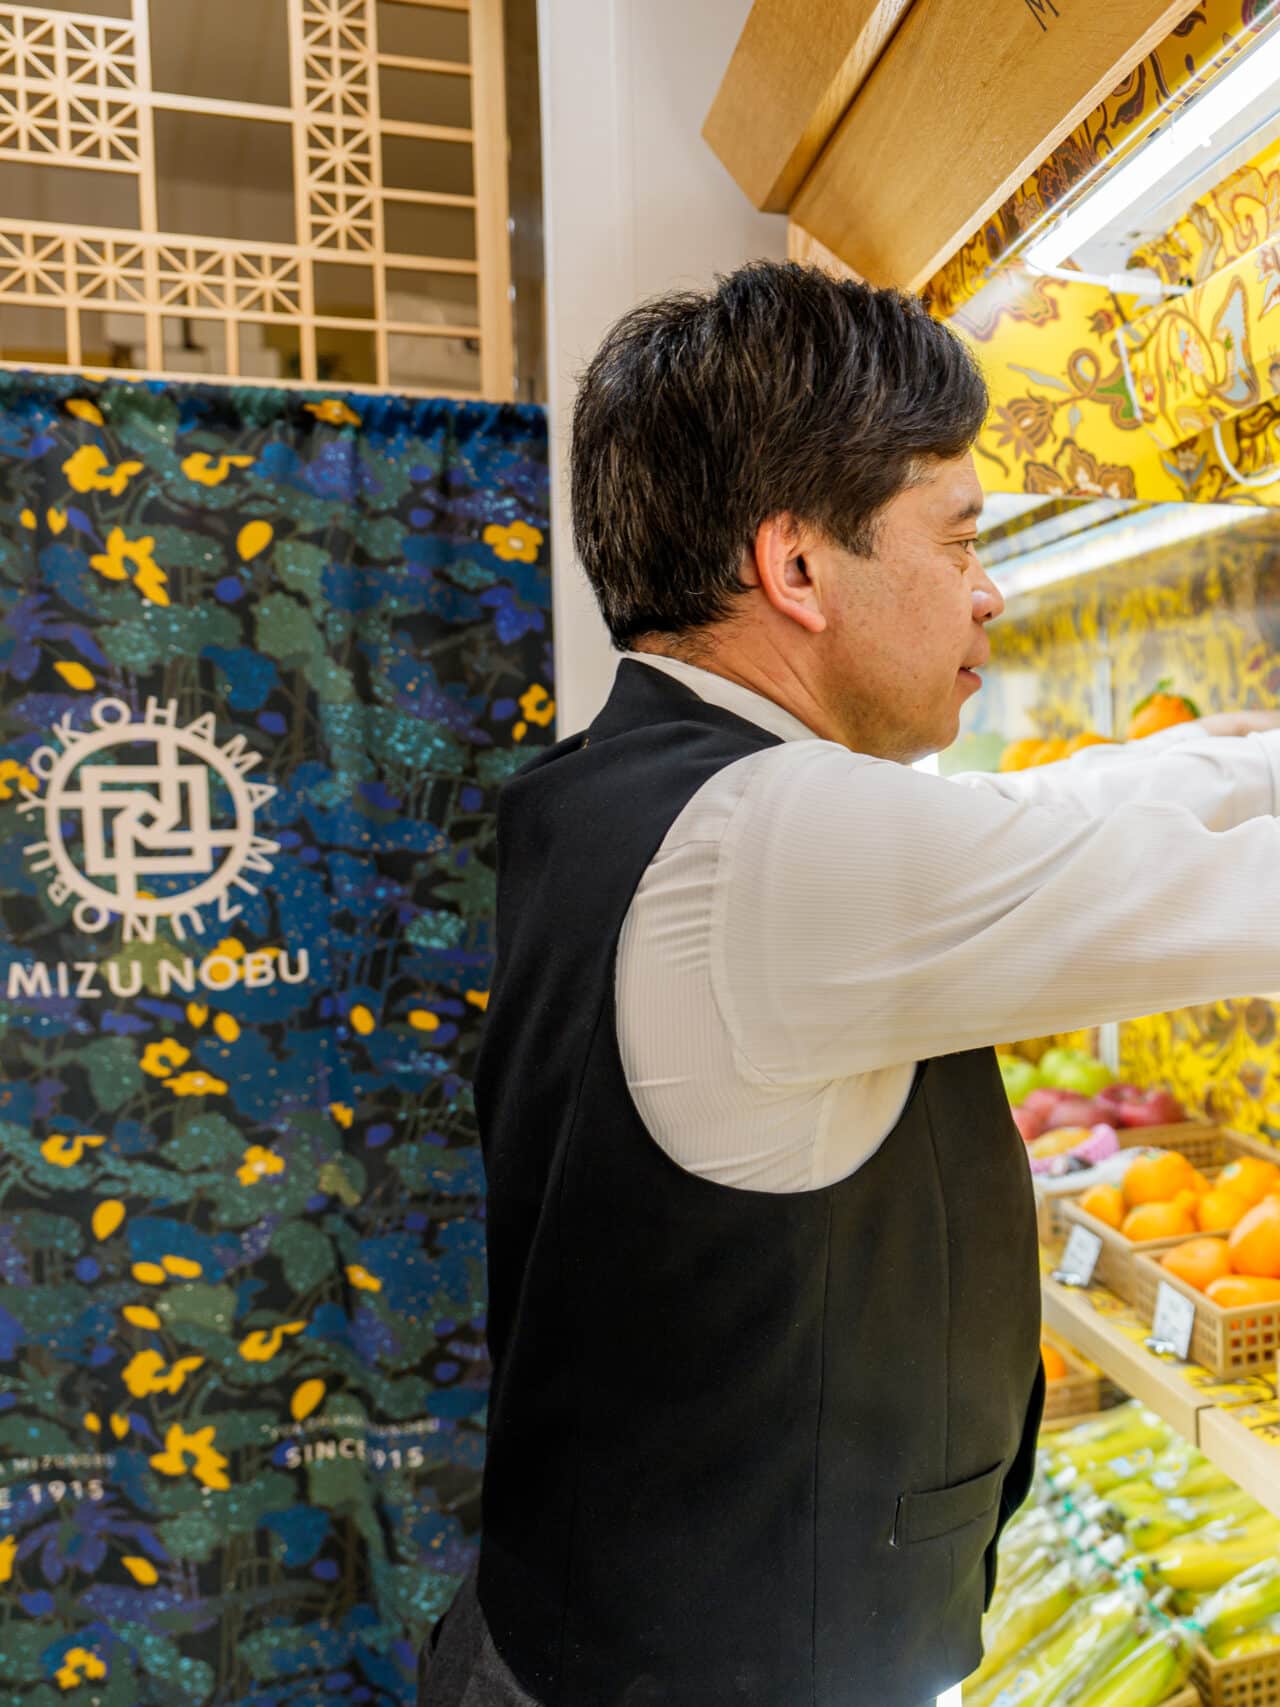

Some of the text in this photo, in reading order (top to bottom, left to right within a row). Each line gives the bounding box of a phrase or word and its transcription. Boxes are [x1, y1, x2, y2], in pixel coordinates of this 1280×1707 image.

[17, 696, 278, 814] YOKOHAMA
[23, 837, 281, 943] MIZUNOBU
[7, 948, 310, 1000] MIZUNOBU
[28, 1479, 104, 1504] 1915
